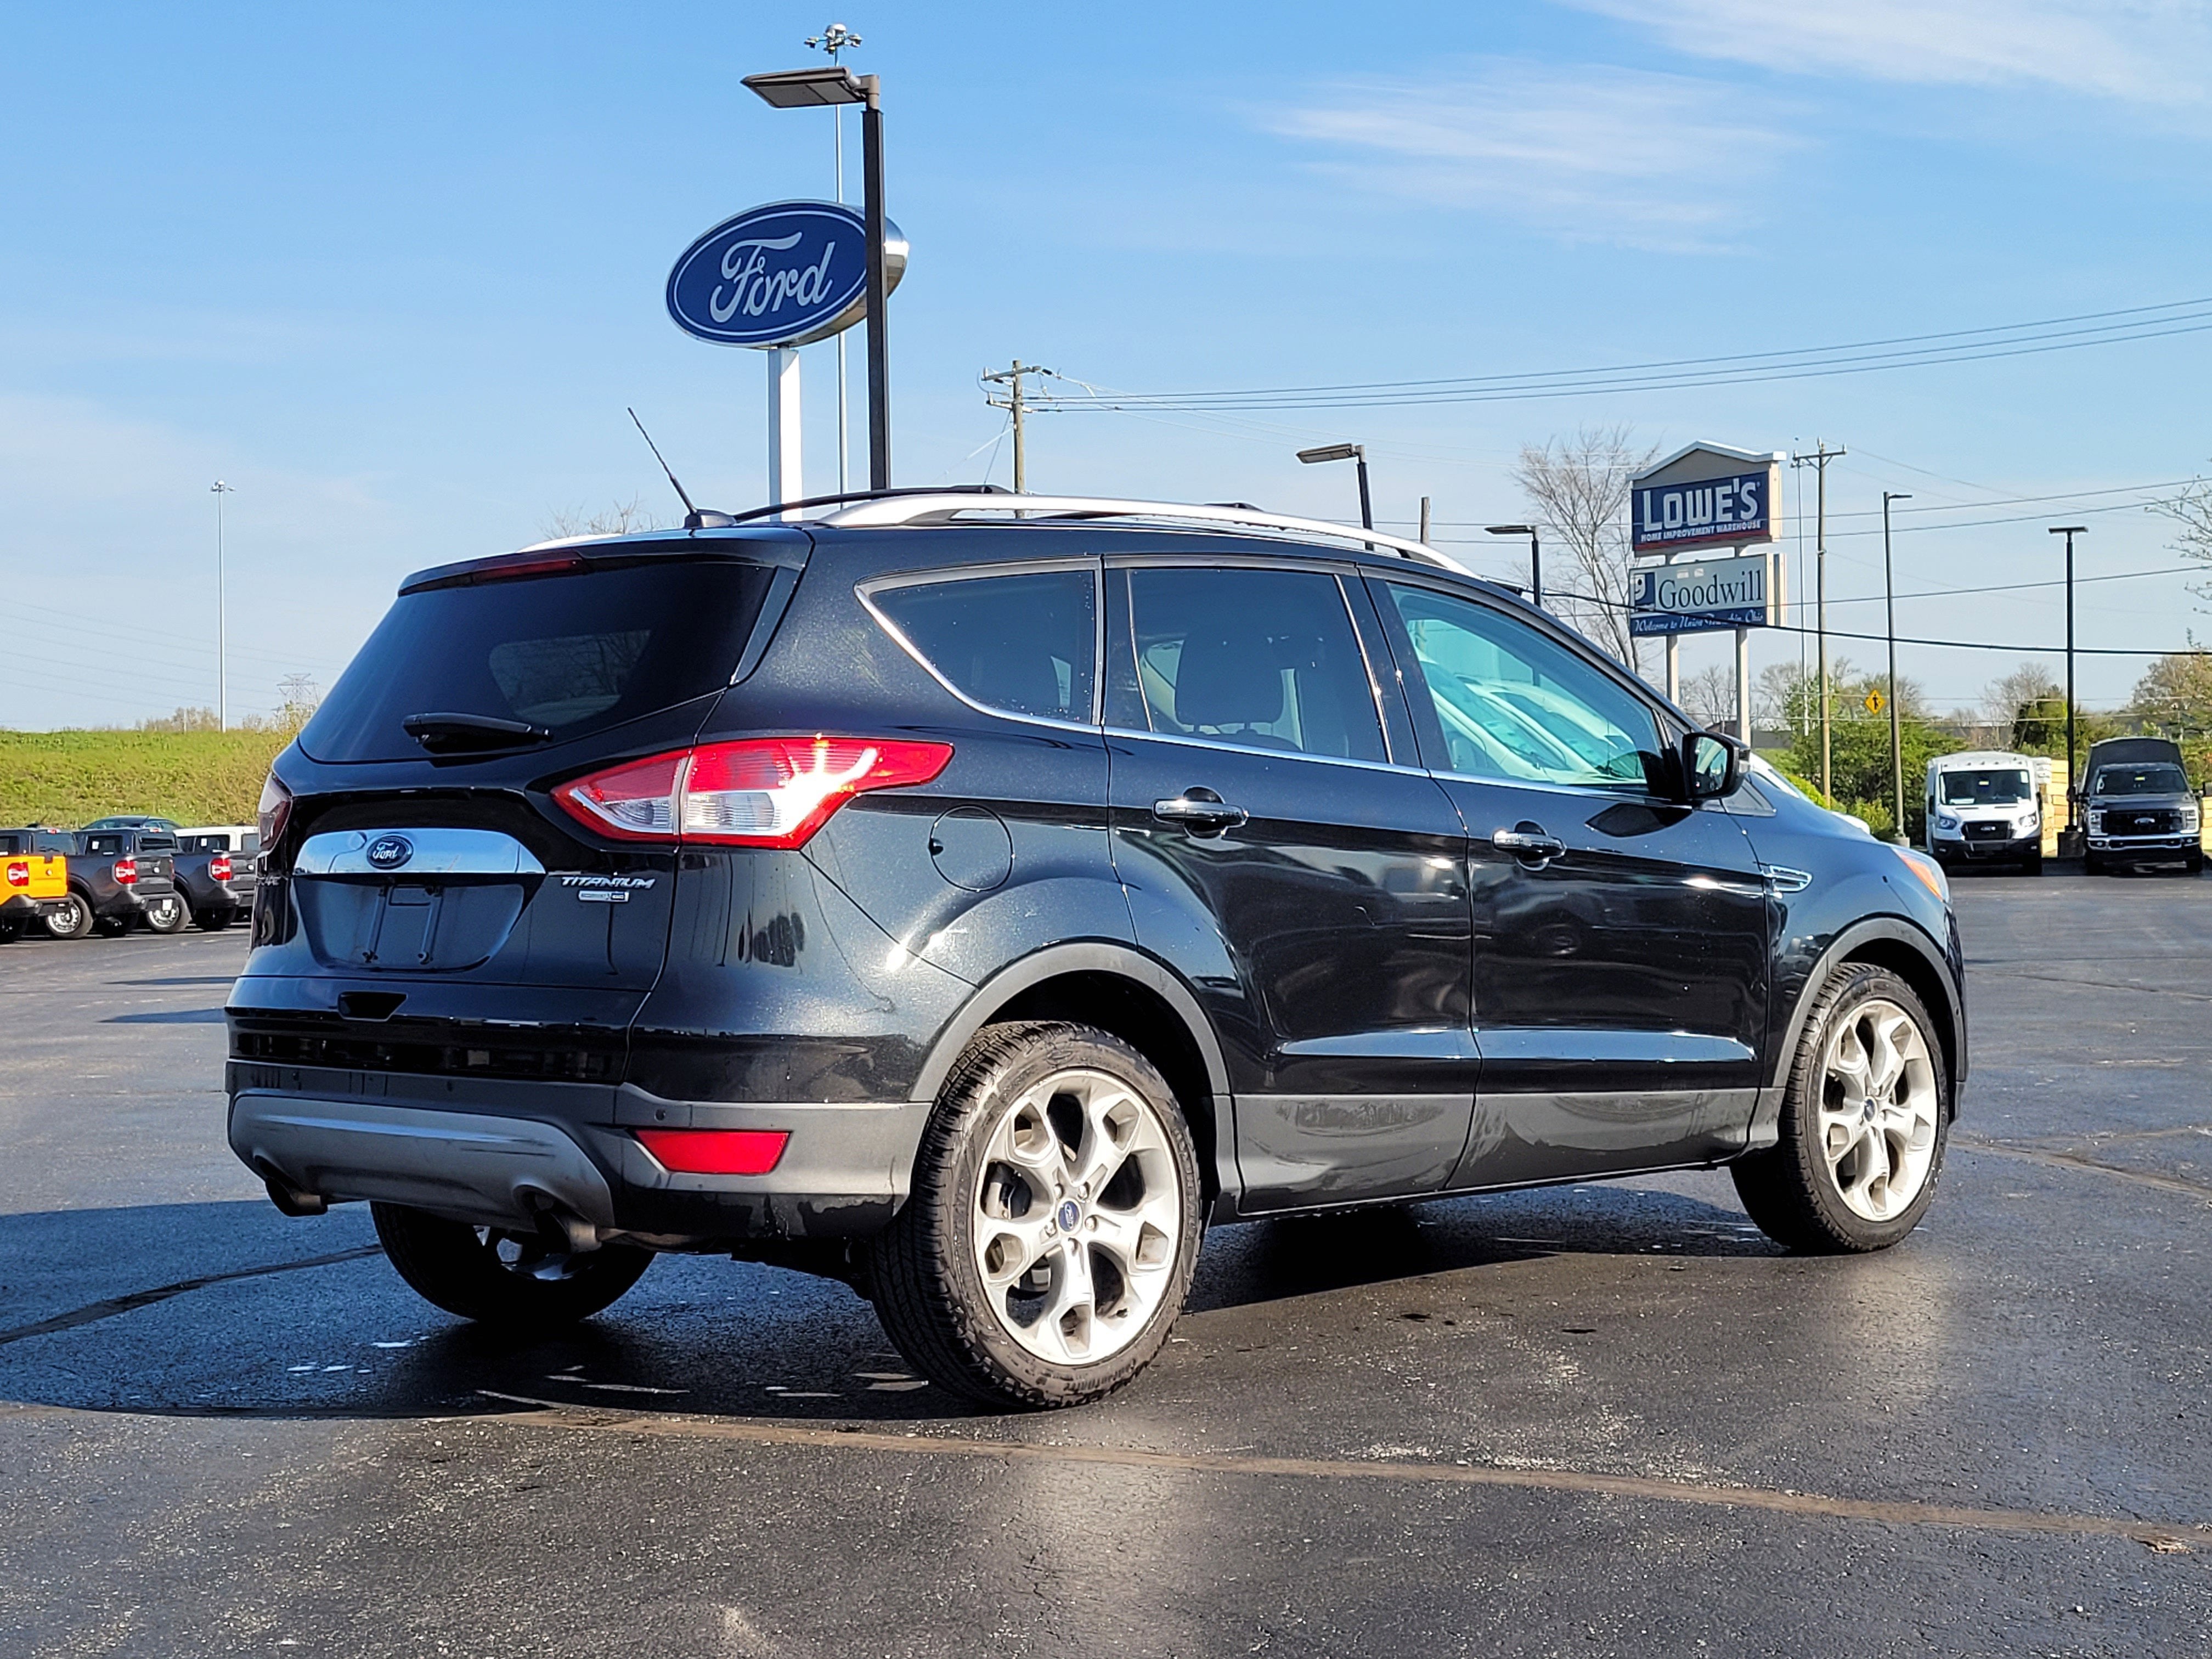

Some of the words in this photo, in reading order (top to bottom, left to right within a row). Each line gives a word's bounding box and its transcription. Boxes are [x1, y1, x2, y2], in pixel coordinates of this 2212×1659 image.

[709, 231, 836, 323] Ford
[1643, 478, 1758, 532] LOWE'S
[1641, 532, 1662, 542] HOME
[1663, 525, 1715, 539] IMPROVEMENT
[1717, 520, 1761, 533] WAREHOUSE
[1658, 569, 1763, 610] Goodwill
[1634, 620, 1668, 631] Welcome
[1670, 620, 1678, 629] to
[372, 842, 400, 860] Ford
[561, 876, 656, 889] TITANIUM
